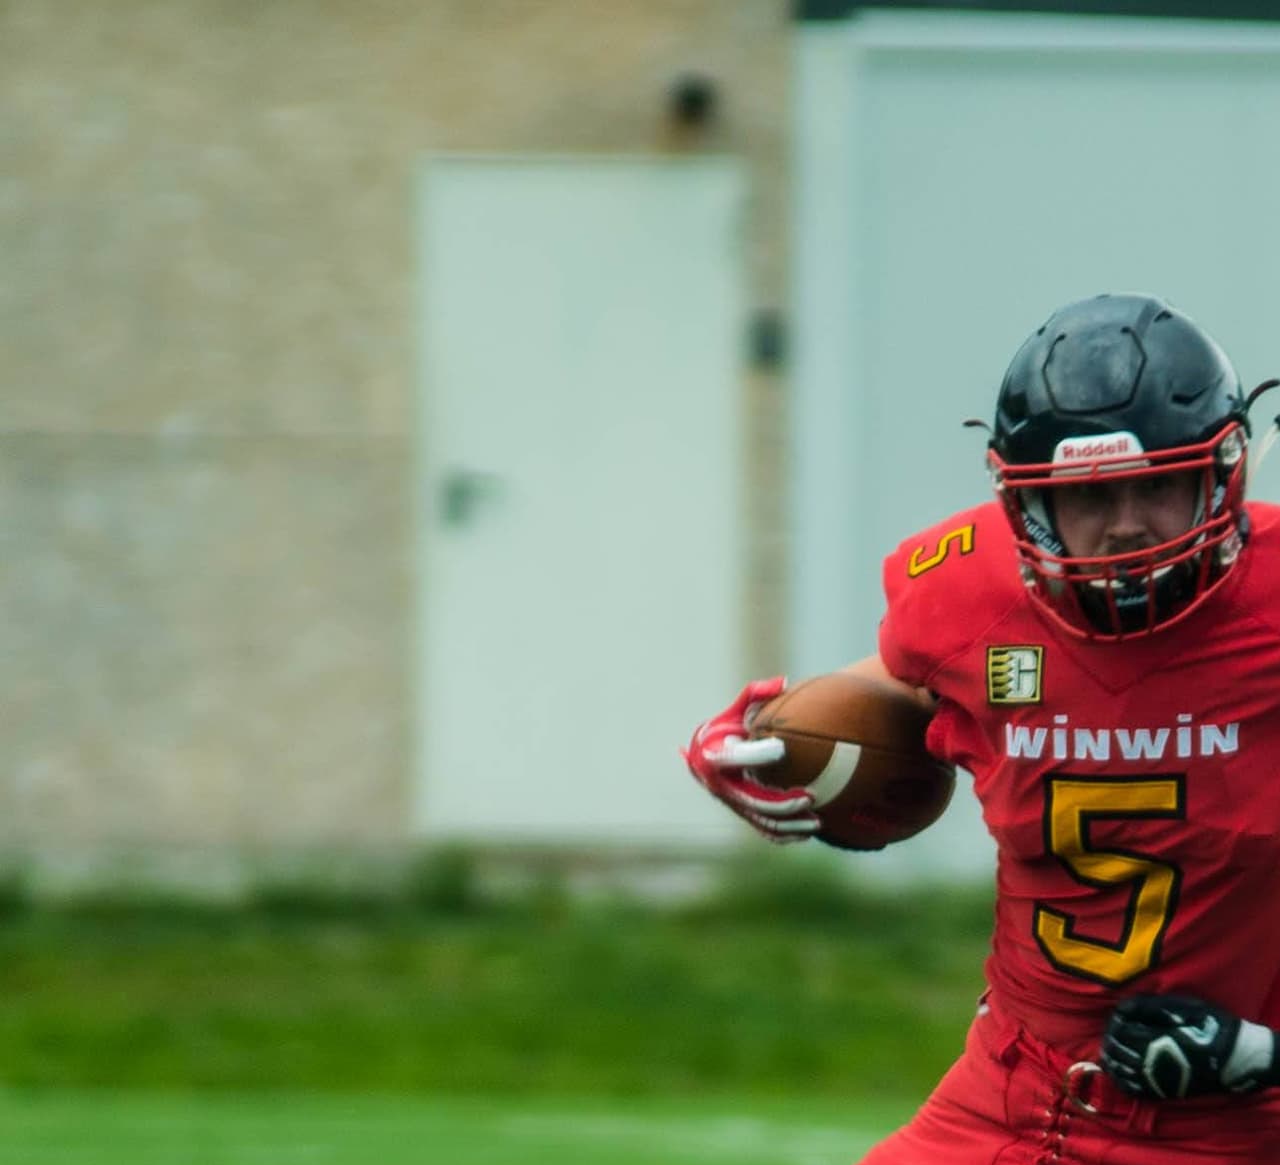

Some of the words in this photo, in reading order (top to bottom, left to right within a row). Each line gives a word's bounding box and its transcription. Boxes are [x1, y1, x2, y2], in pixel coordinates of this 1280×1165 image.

[1062, 438, 1130, 459] Riddell
[908, 523, 976, 578] 5
[1035, 775, 1186, 984] 5
